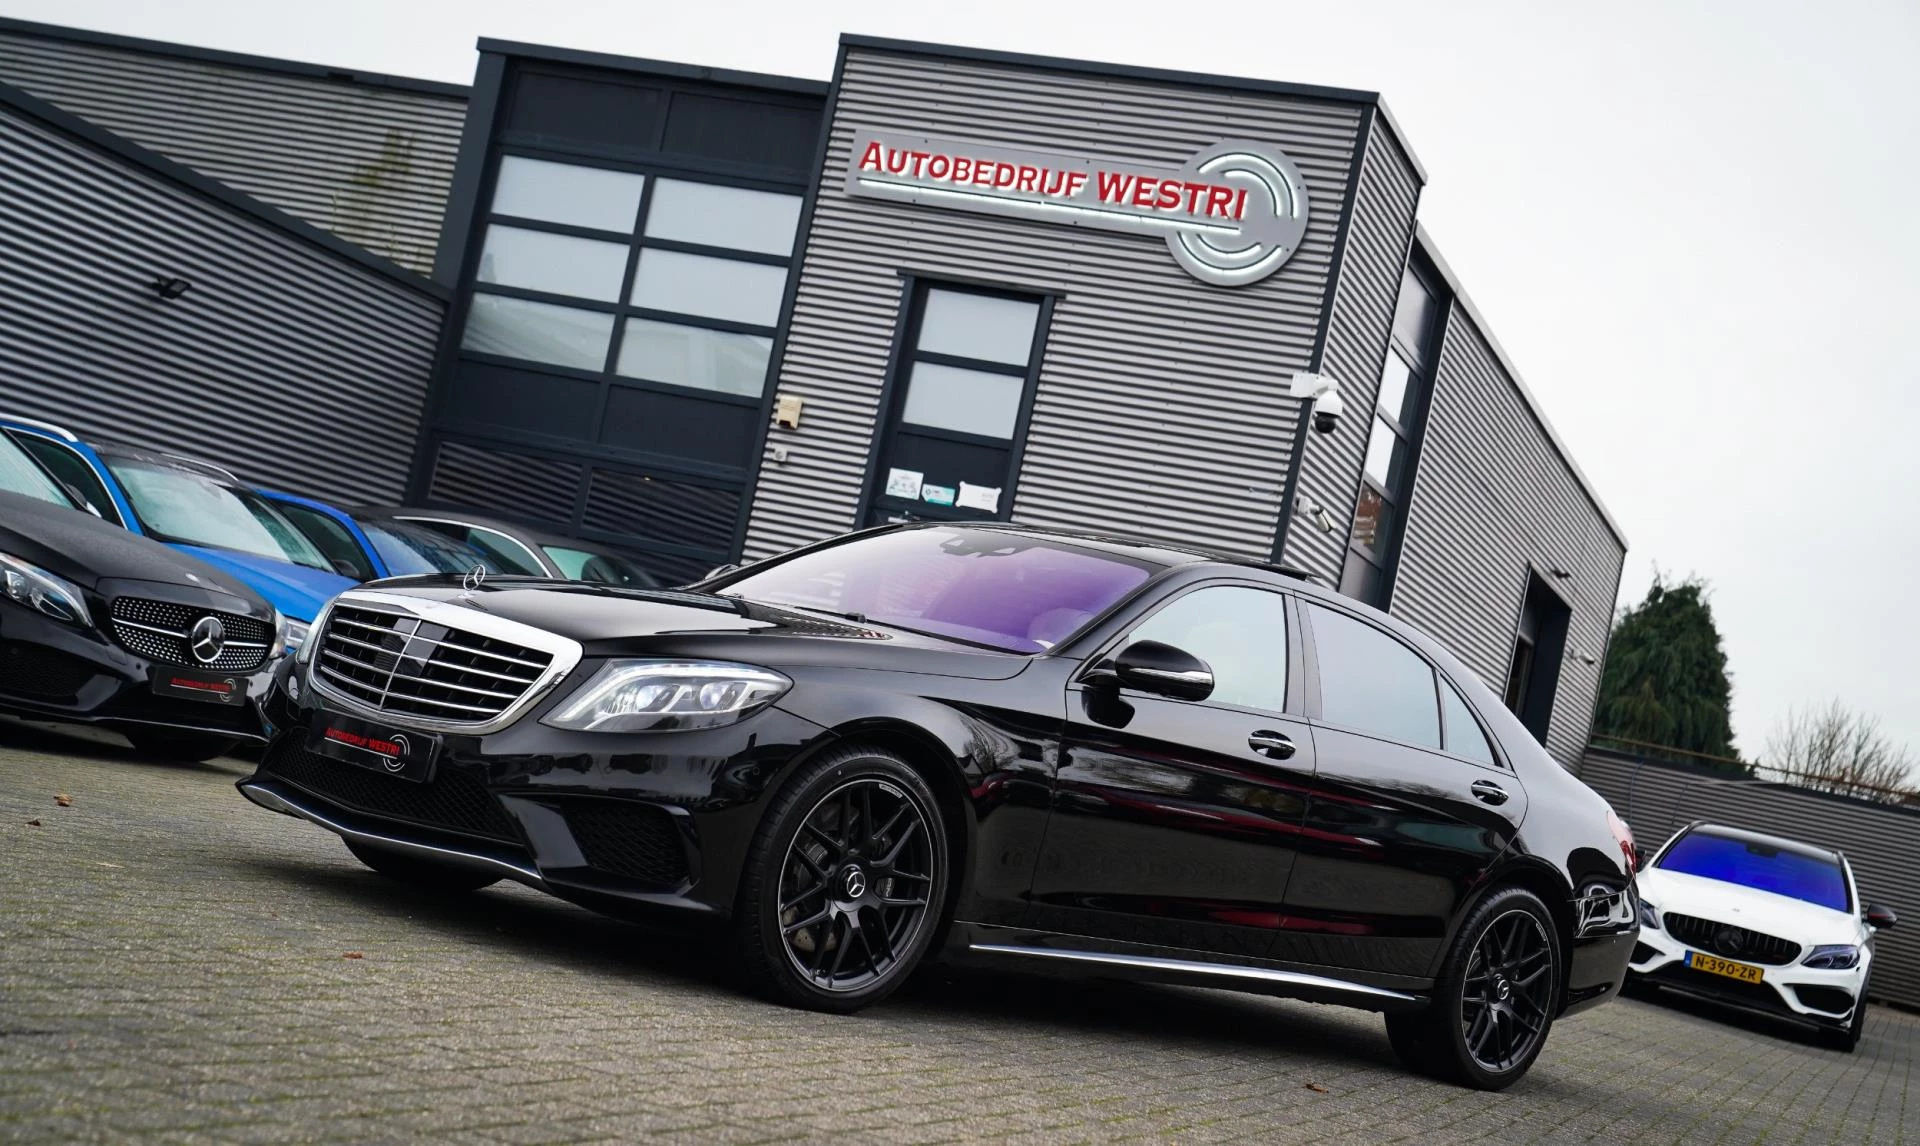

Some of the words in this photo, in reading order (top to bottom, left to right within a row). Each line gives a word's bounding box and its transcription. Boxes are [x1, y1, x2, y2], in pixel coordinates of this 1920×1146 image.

[859, 142, 1086, 196] AUTOBEDRIJF
[1097, 171, 1246, 219] WESTRI
[368, 738, 401, 756] WESTRI
[1695, 955, 1757, 980] N-390-ZR
